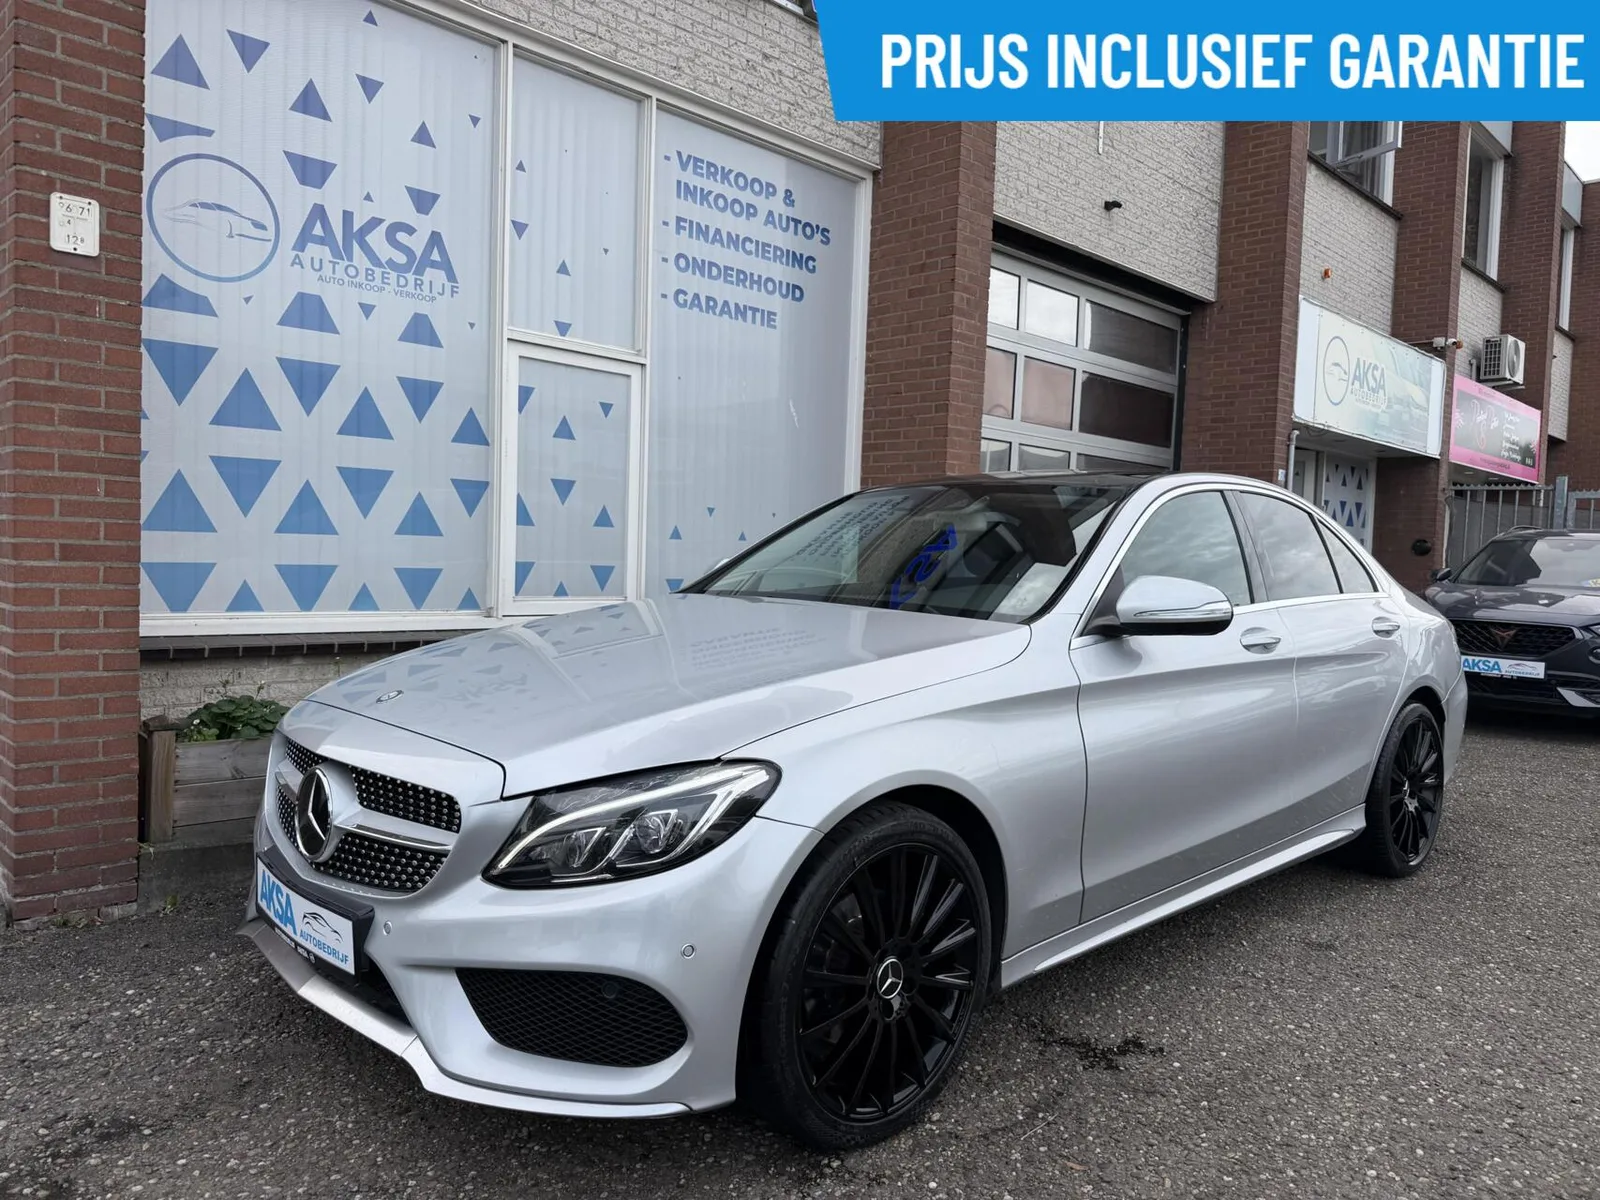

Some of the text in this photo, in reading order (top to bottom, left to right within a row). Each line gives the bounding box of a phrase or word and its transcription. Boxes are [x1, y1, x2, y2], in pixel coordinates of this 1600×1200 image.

[676, 150, 777, 200] VERKOOP
[782, 188, 796, 208] &
[675, 179, 831, 246] INKOOP AUTO'S
[292, 202, 459, 284] AKSA
[675, 215, 817, 274] FINANCIERING
[289, 253, 460, 299] AUTOBEDRIJF
[317, 274, 345, 287] AUTO
[347, 281, 386, 294] INKOOP
[393, 288, 437, 304] VERKOOP
[674, 252, 805, 302] ONDERHOUD
[673, 288, 778, 330] GARANTIE
[1351, 357, 1386, 398] AKSA
[1462, 658, 1502, 673] AKSA
[260, 870, 297, 935] AKSA
[300, 930, 349, 964] AUTOBEDRIJF
